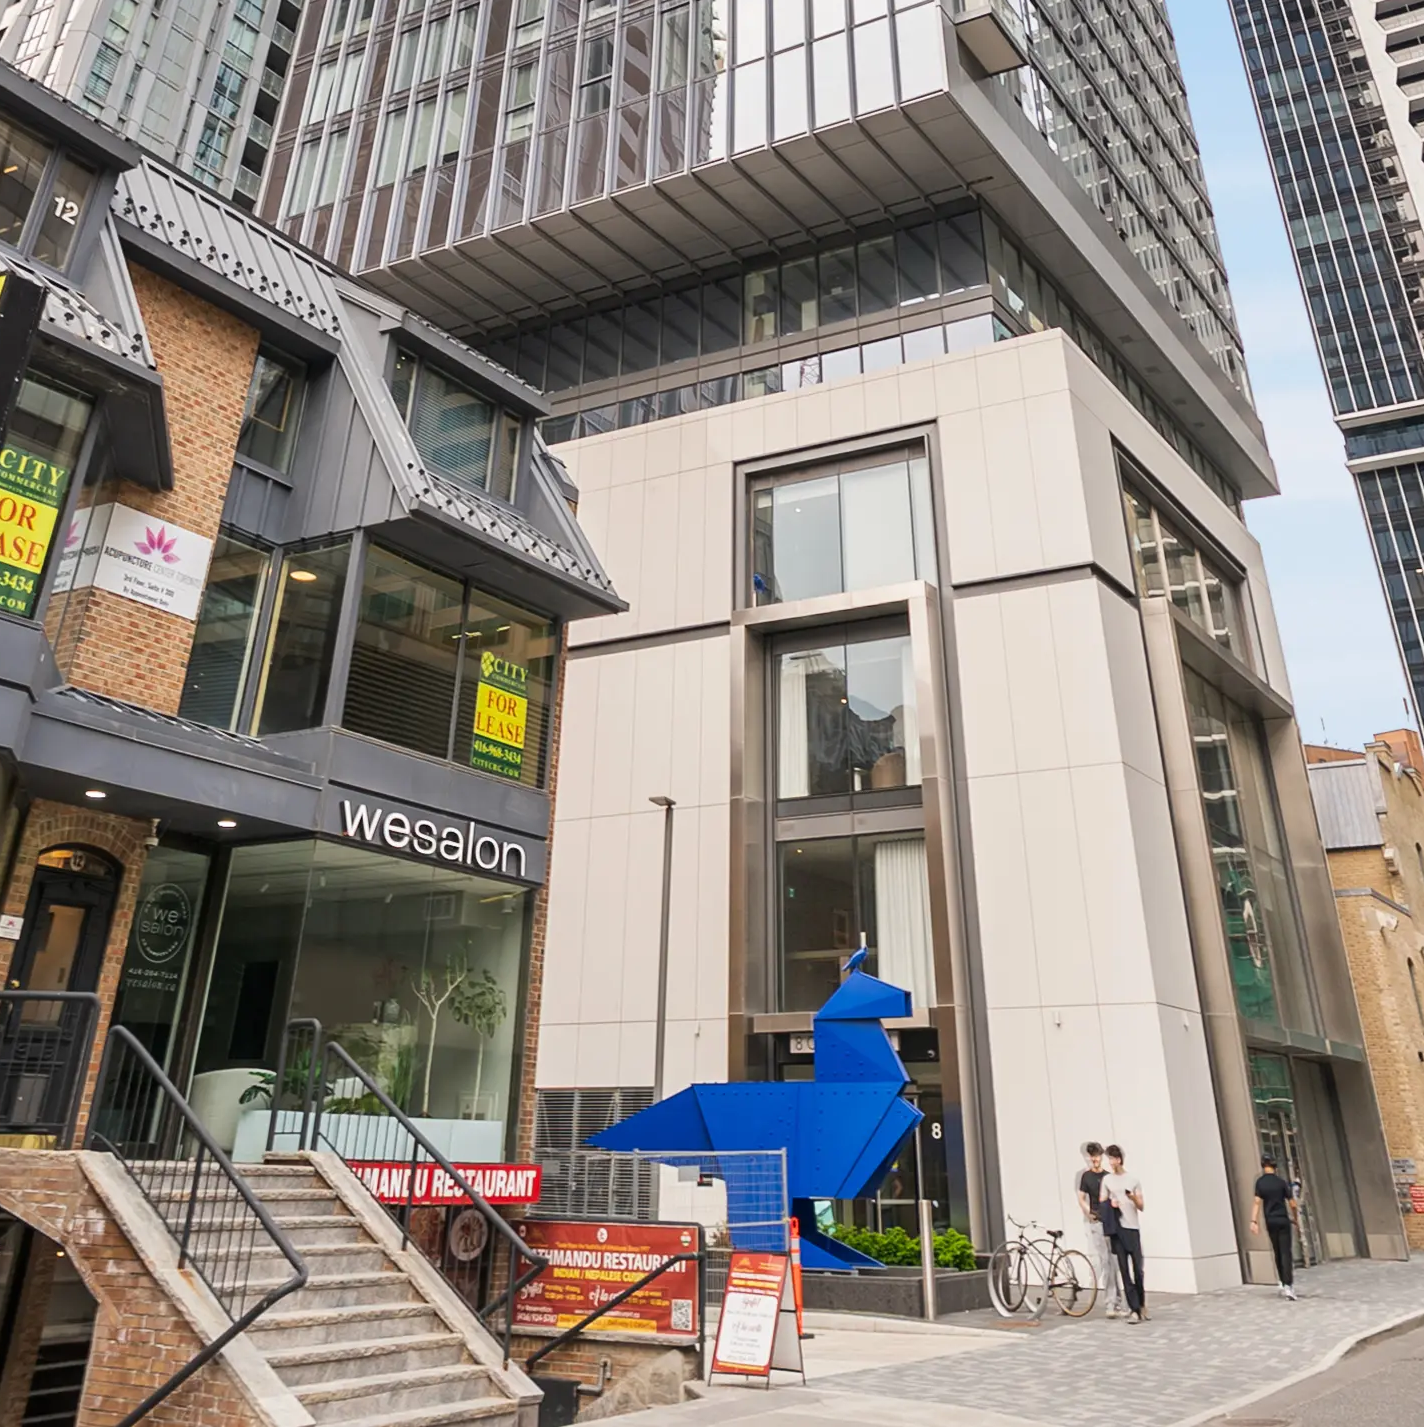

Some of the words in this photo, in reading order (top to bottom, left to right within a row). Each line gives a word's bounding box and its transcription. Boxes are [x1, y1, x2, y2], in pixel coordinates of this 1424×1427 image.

[0, 449, 65, 487] CITY
[104, 546, 153, 571] ACUPUNCTURE
[494, 658, 528, 683] CITY
[487, 690, 517, 717] FOR
[477, 711, 525, 744] LEASE
[342, 800, 526, 877] wesalon
[153, 907, 178, 923] we
[141, 920, 184, 937] salon
[931, 1123, 942, 1139] 8
